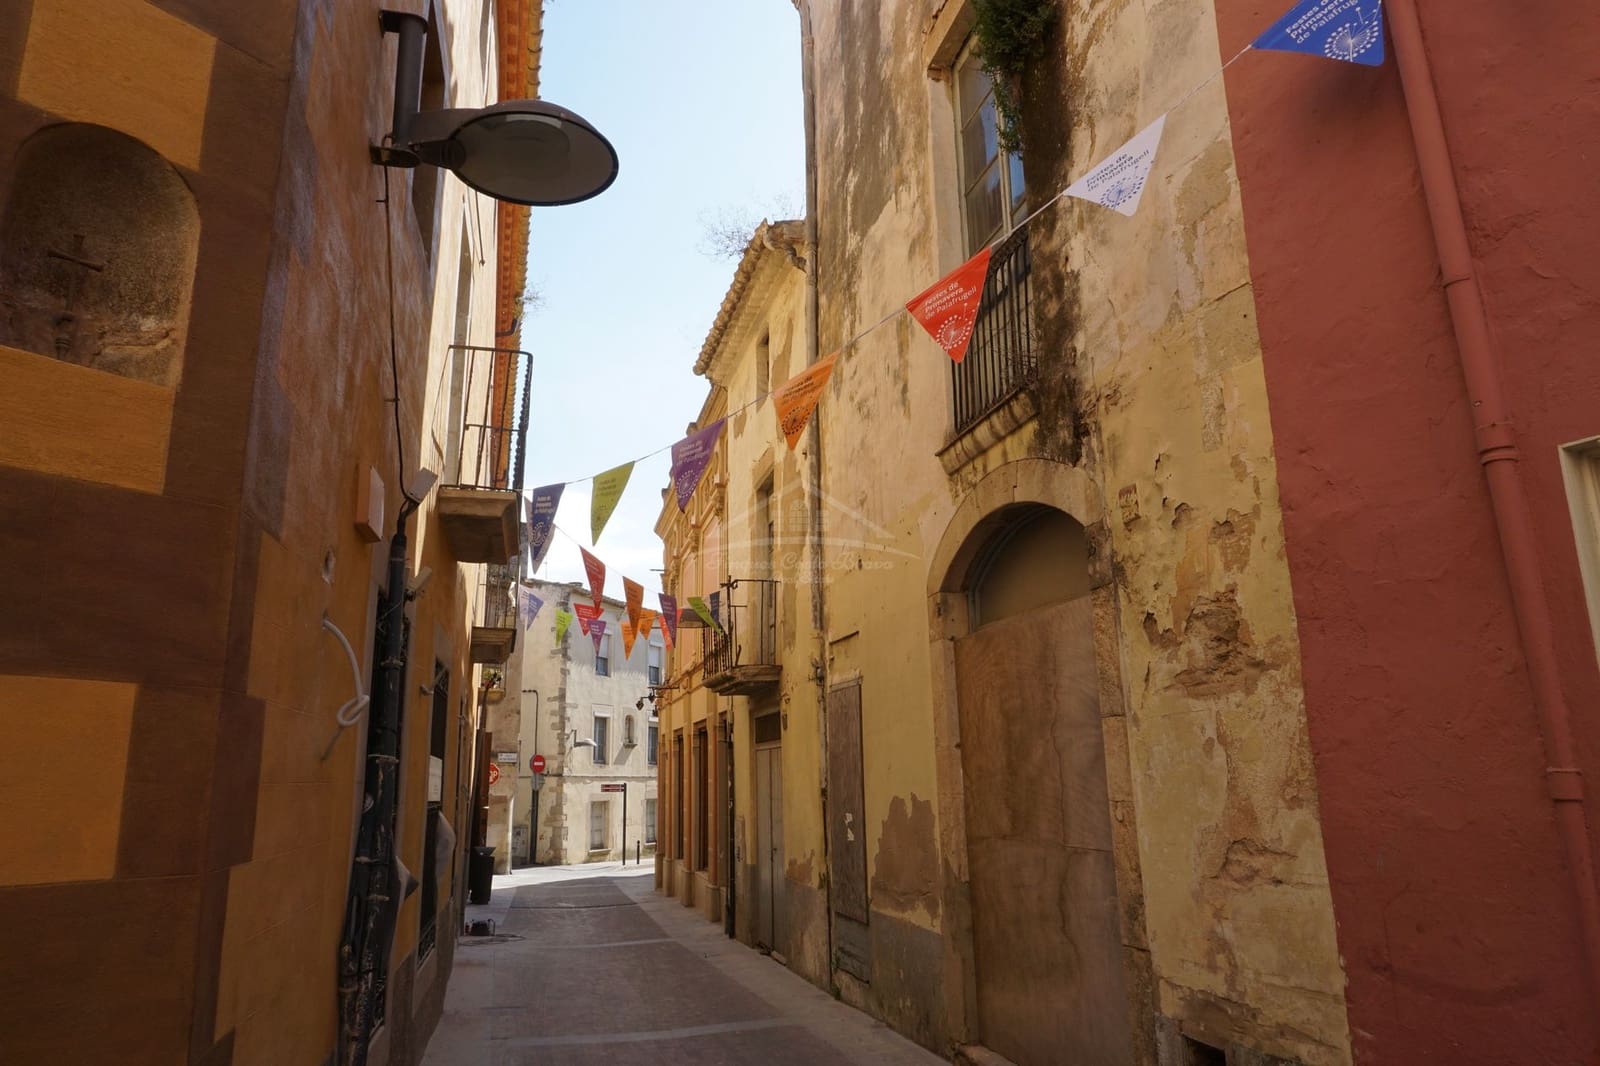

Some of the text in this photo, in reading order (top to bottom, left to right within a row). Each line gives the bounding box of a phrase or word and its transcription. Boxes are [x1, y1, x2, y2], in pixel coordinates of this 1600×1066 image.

[1285, 6, 1320, 34] Festes
[1296, 31, 1311, 44] de
[948, 281, 959, 292] de
[936, 284, 977, 314] Palafrugell
